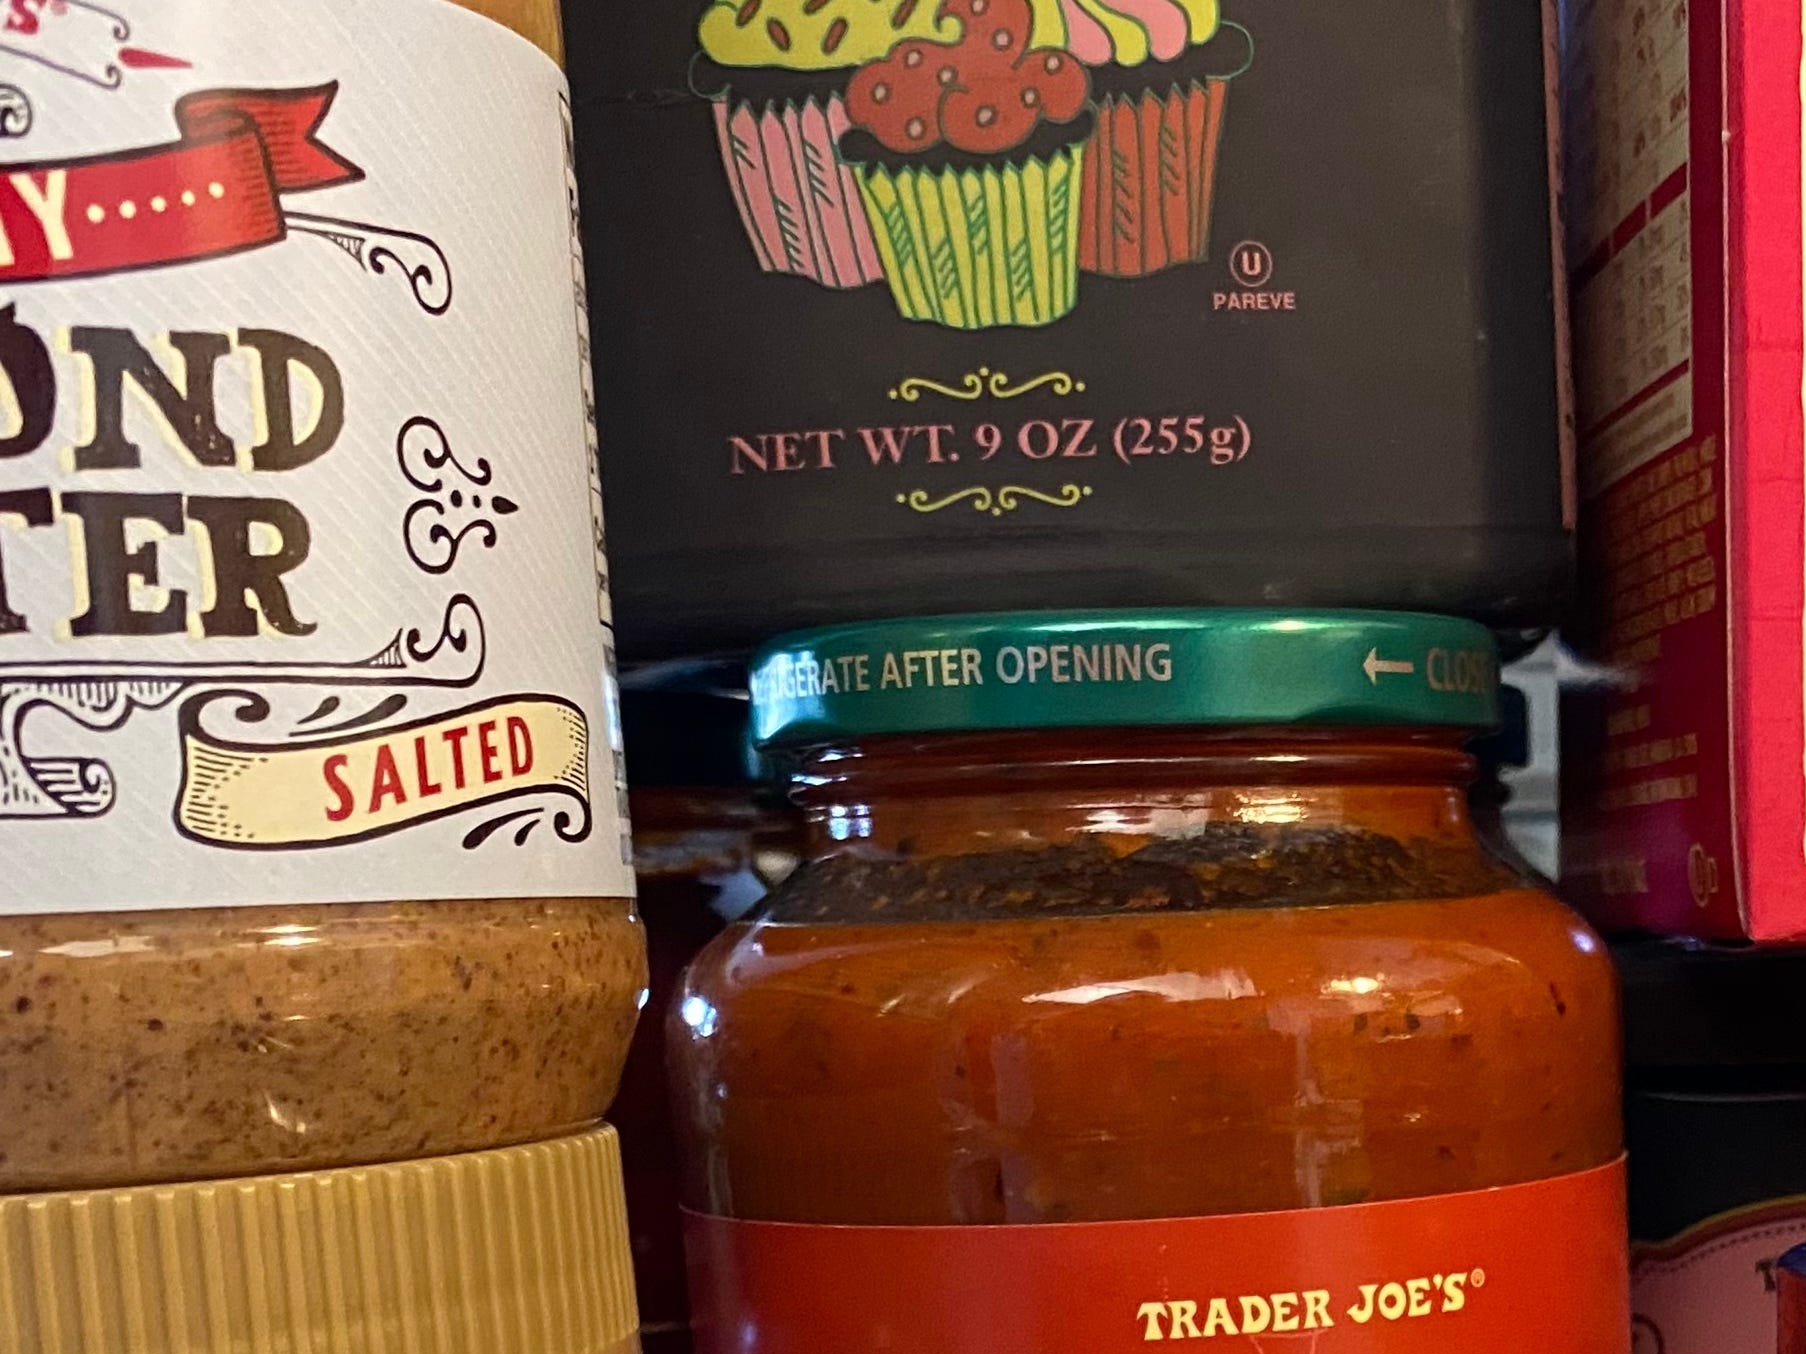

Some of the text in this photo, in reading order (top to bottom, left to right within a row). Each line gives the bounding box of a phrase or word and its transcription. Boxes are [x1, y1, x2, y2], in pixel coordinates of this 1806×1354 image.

[1212, 291, 1296, 311] PAREVE
[729, 414, 1251, 475] NET WT. 9 OZ (255g)
[881, 649, 983, 690] AFTER
[998, 645, 1173, 684] OPENING
[323, 716, 535, 822] SALTED
[1136, 1290, 1332, 1341] TRADER
